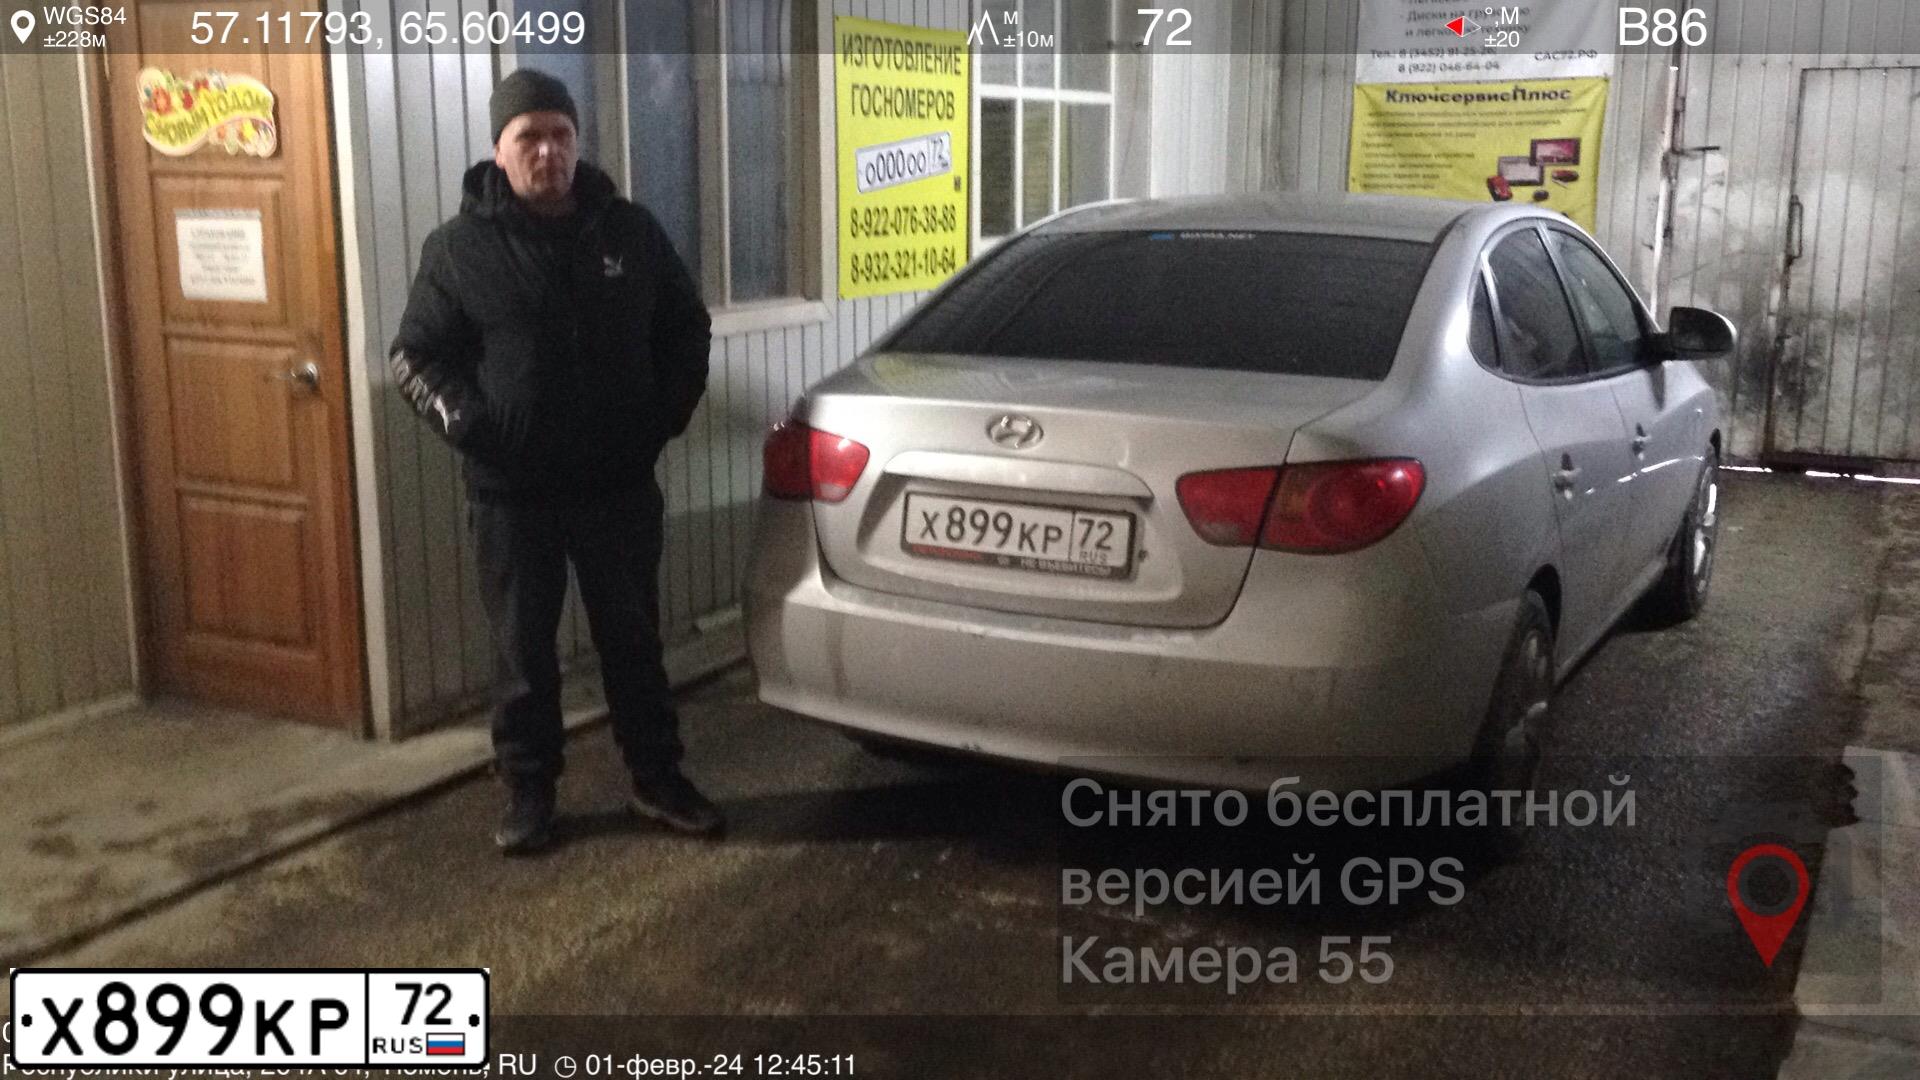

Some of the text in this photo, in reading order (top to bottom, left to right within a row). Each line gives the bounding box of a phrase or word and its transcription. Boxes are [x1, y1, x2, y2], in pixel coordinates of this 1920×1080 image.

[842, 33, 962, 76] ИЗГОТОВЛЕНИЕ
[852, 83, 955, 121] ГОСНОМЕРОВ
[850, 203, 957, 239] 8-922-076-38-88
[850, 244, 956, 284] 8-932-321-10-64
[1078, 518, 1113, 550] 72
